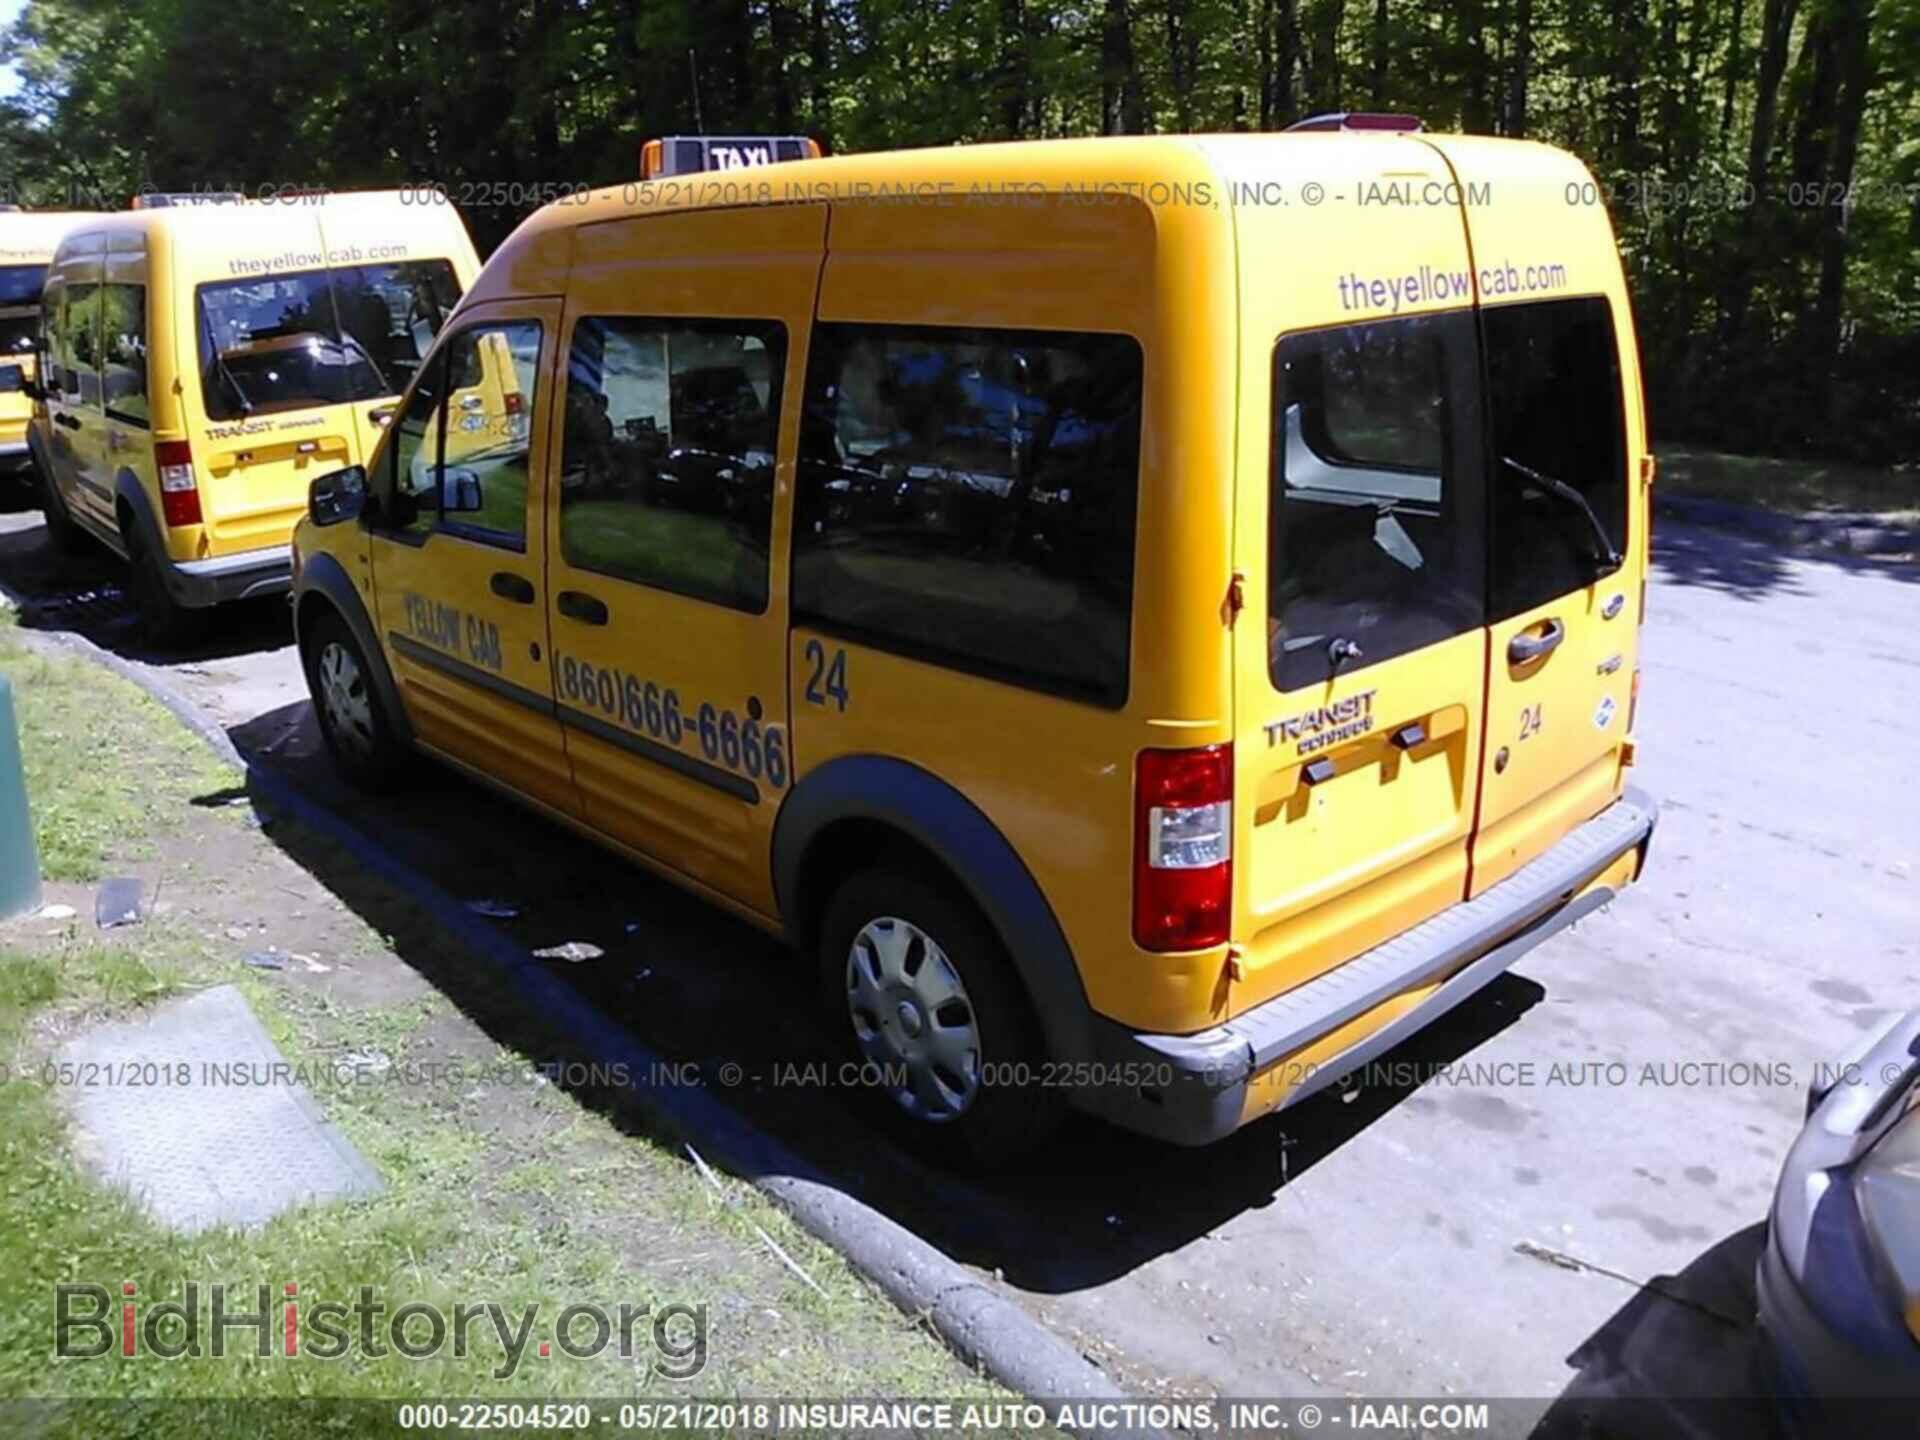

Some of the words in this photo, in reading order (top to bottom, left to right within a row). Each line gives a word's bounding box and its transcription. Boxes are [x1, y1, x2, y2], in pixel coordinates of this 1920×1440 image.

[711, 146, 769, 172] TAXI
[403, 592, 461, 652] YELLOW
[467, 612, 503, 673] CAB
[804, 638, 849, 713] 24
[553, 647, 787, 788] (860)666-6666
[1262, 688, 1377, 748] TRANSIT
[1519, 702, 1542, 741] 24
